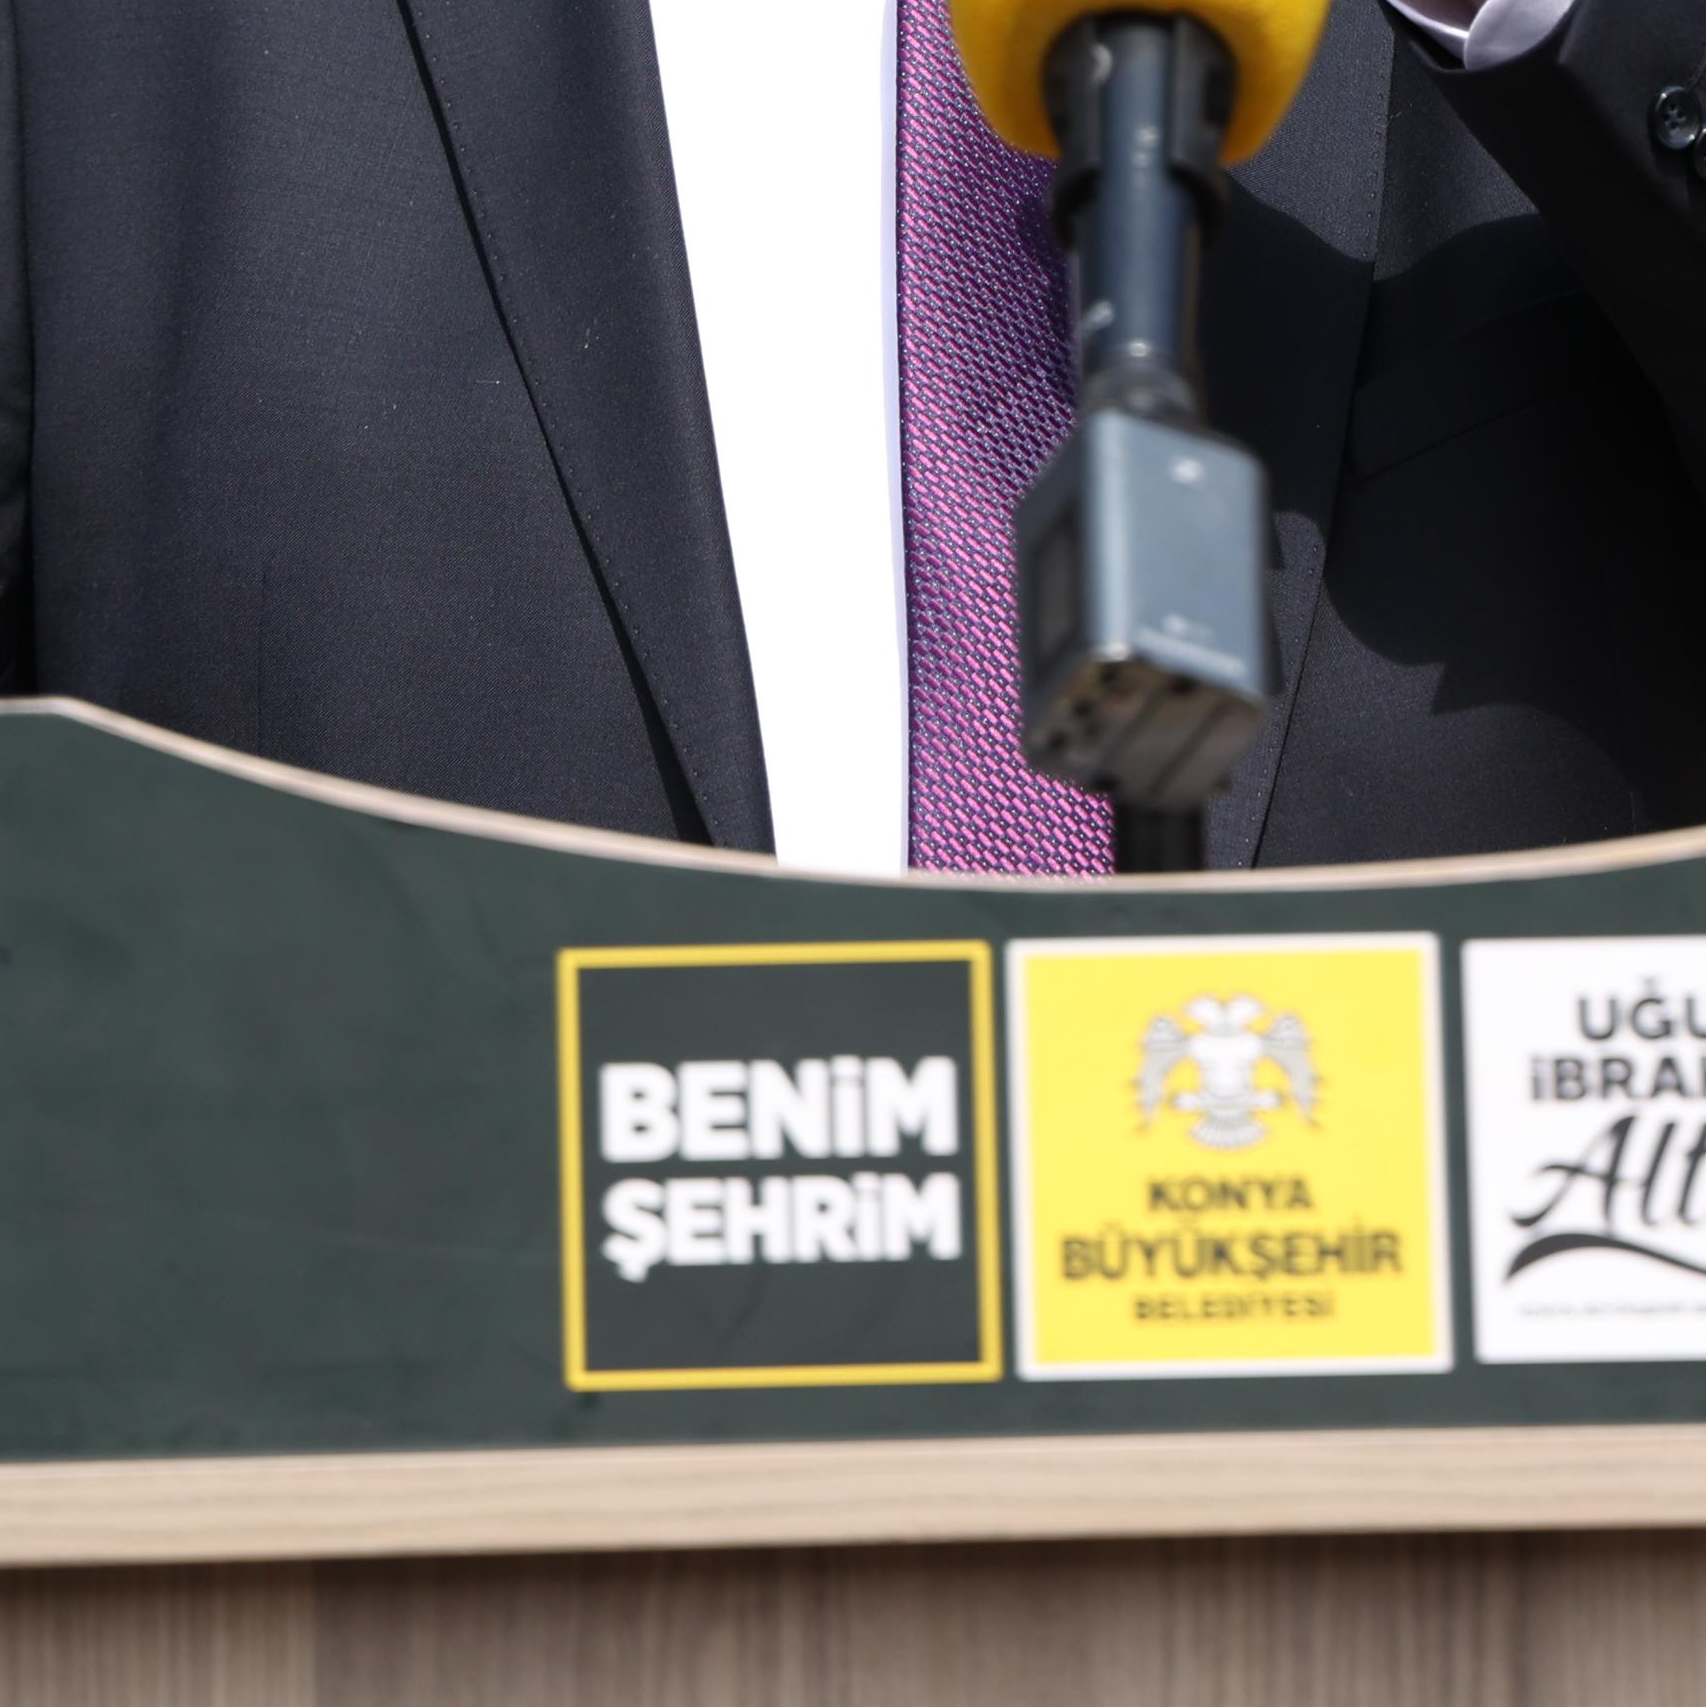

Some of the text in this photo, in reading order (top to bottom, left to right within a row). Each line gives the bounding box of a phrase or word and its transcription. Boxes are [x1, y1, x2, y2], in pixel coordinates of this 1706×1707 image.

[599, 1054, 958, 1163] BENİM
[601, 1170, 962, 1283] ŞEHRİM
[1148, 1177, 1315, 1212] KONYA
[1061, 1219, 1403, 1281] BÜYÜKŞEHİR
